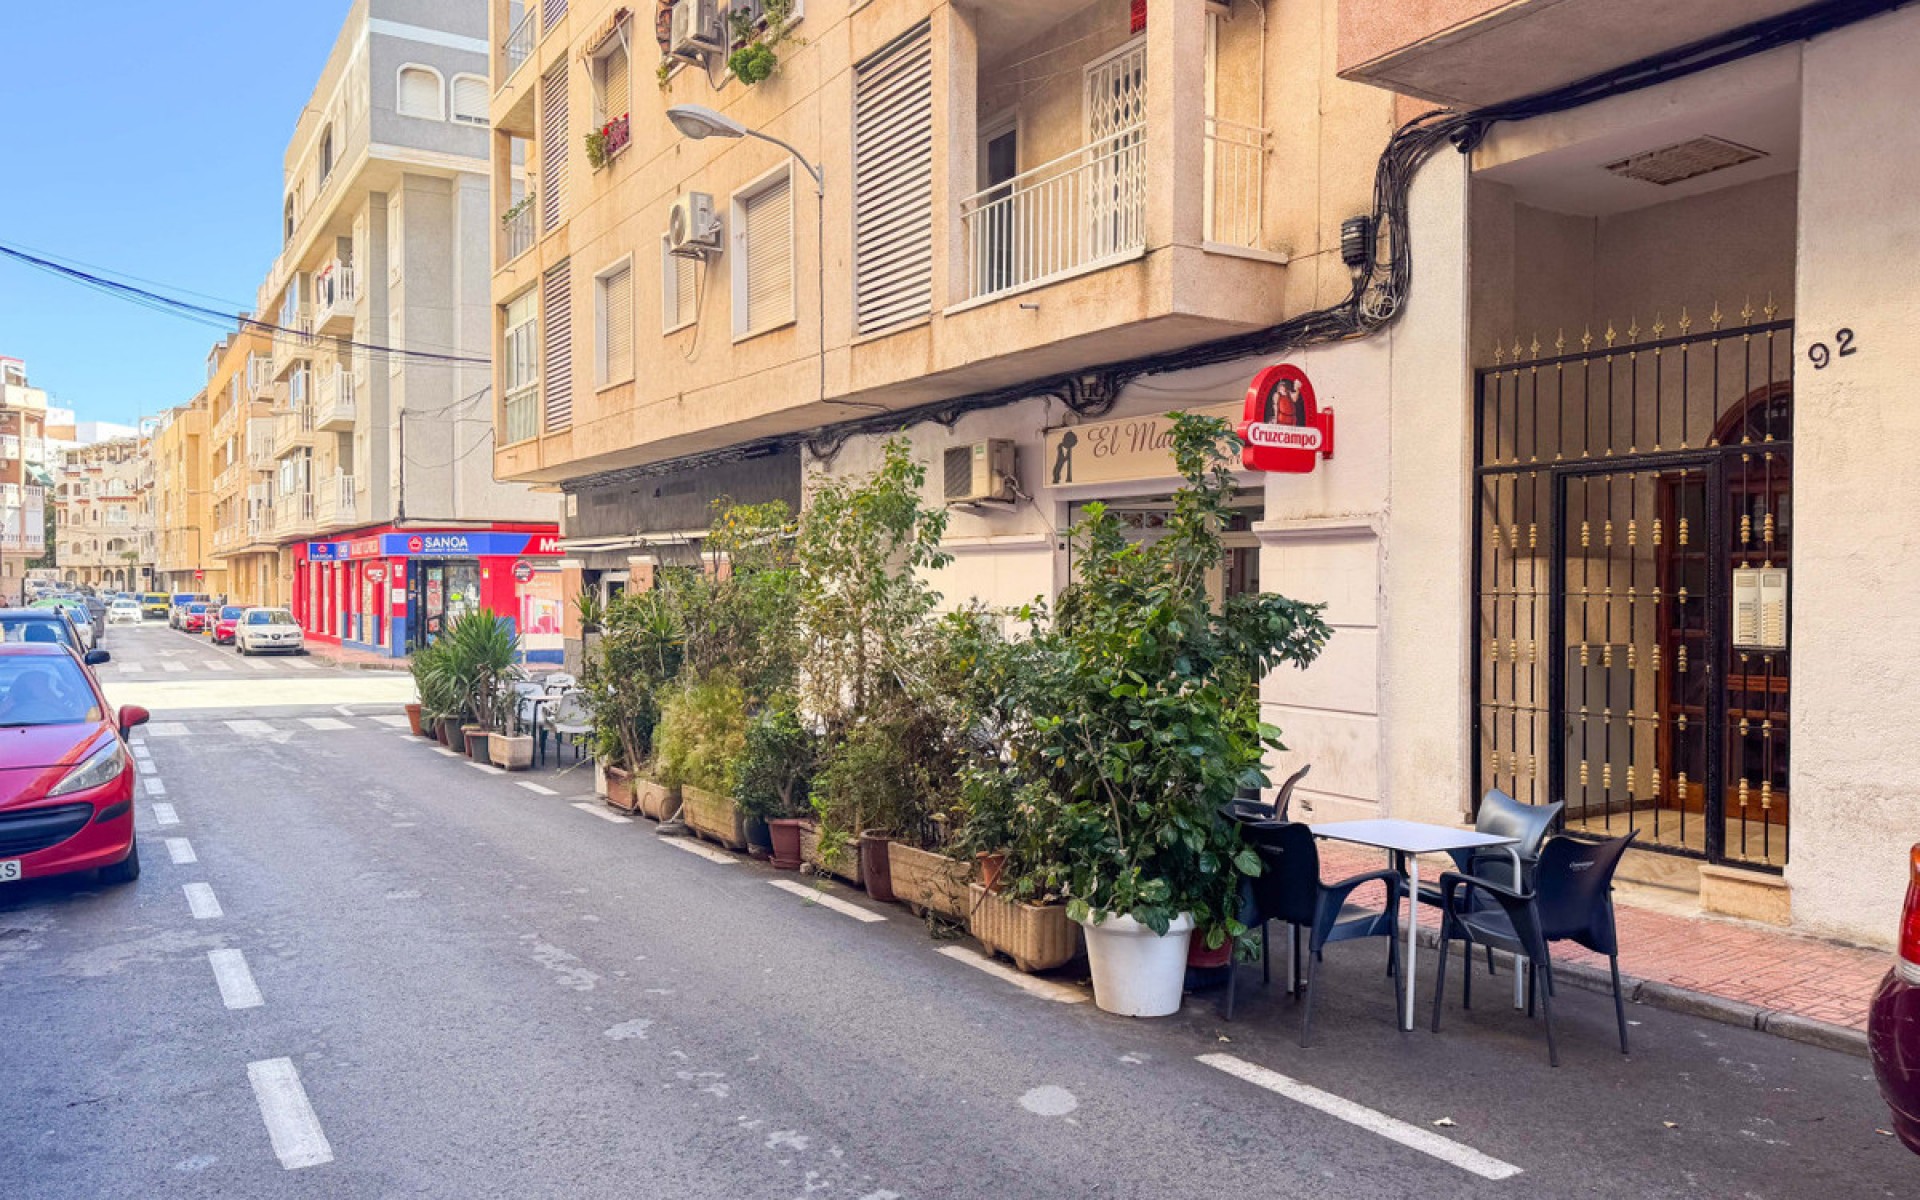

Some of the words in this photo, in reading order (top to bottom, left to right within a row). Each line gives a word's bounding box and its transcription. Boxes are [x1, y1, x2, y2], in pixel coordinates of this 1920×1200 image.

[1808, 329, 1857, 369] 92
[1088, 426, 1120, 458] El
[1252, 427, 1317, 446] Cruzcampo
[425, 536, 468, 548] SANOA
